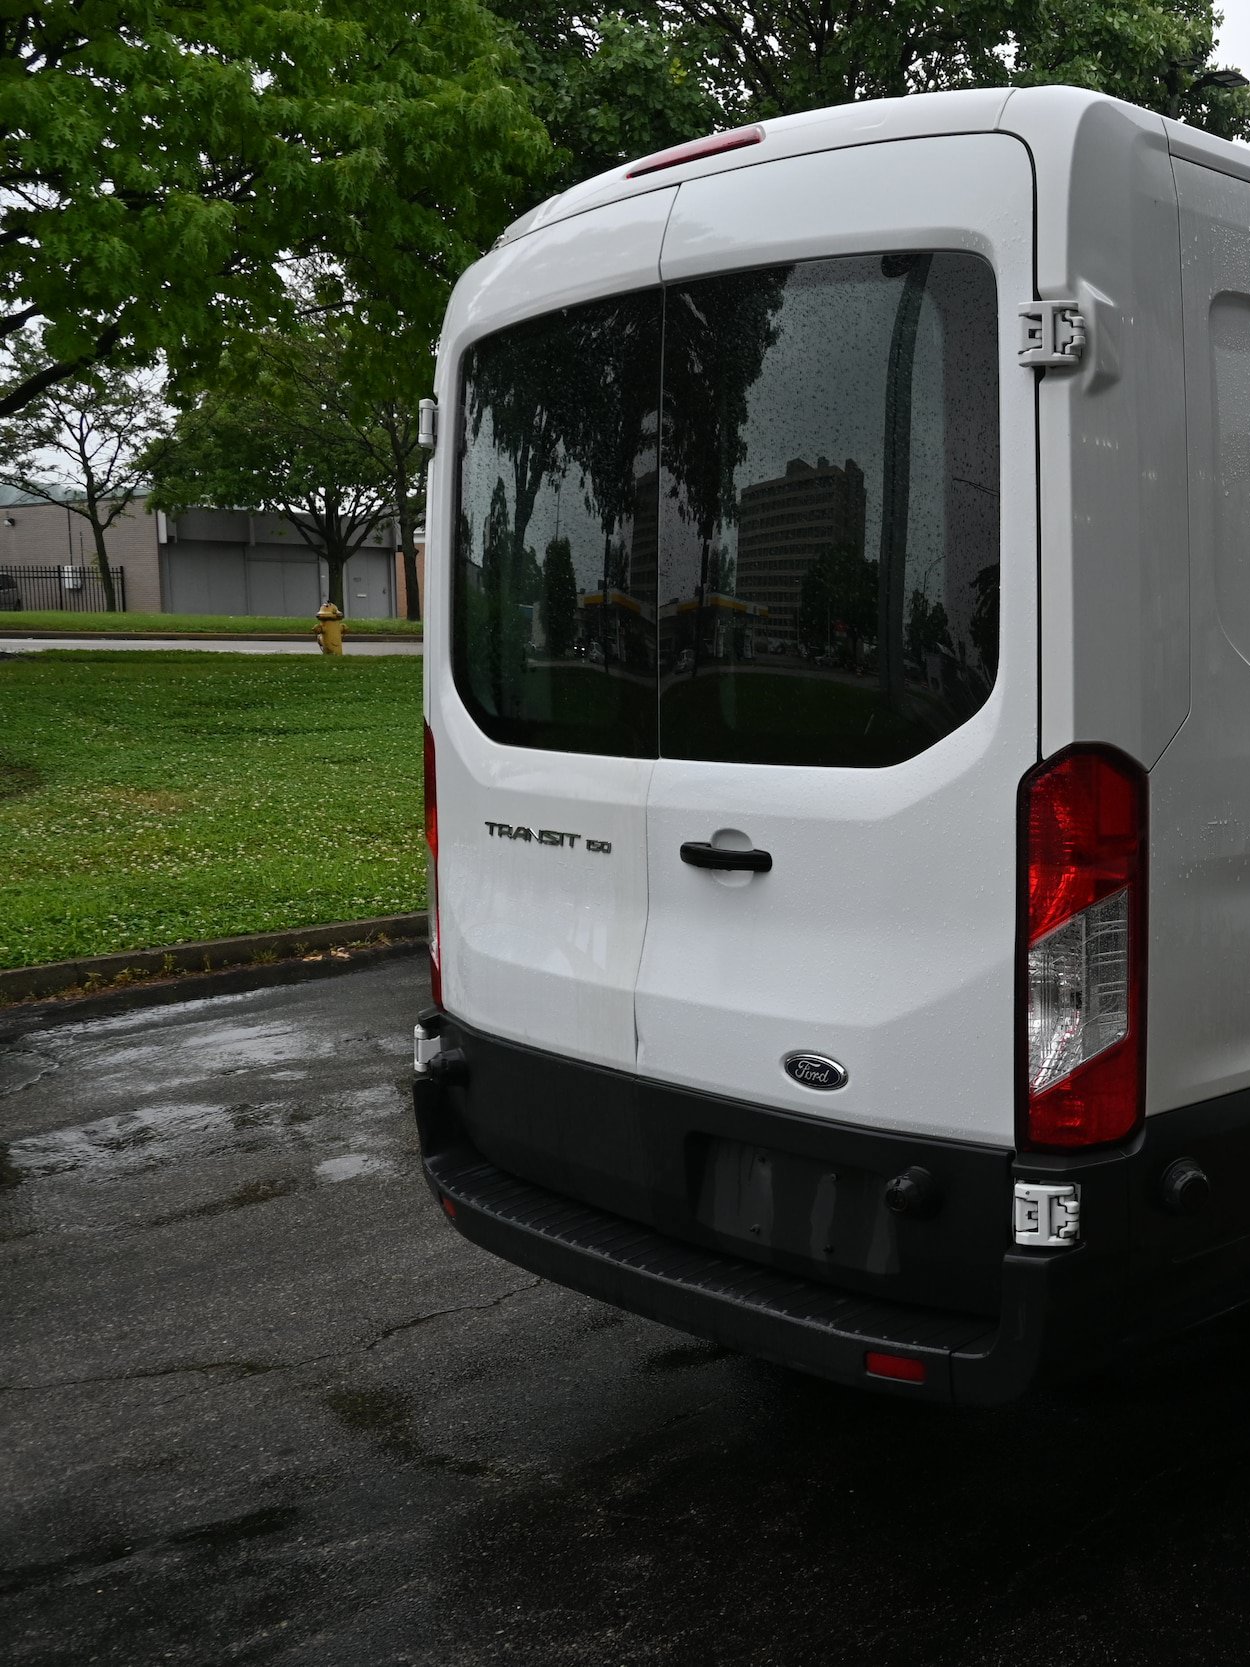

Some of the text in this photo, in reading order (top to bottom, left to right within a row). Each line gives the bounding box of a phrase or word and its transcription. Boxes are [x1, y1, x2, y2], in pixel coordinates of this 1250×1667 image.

[485, 821, 612, 854] TRANSIT 150
[795, 1060, 830, 1083] Ford
